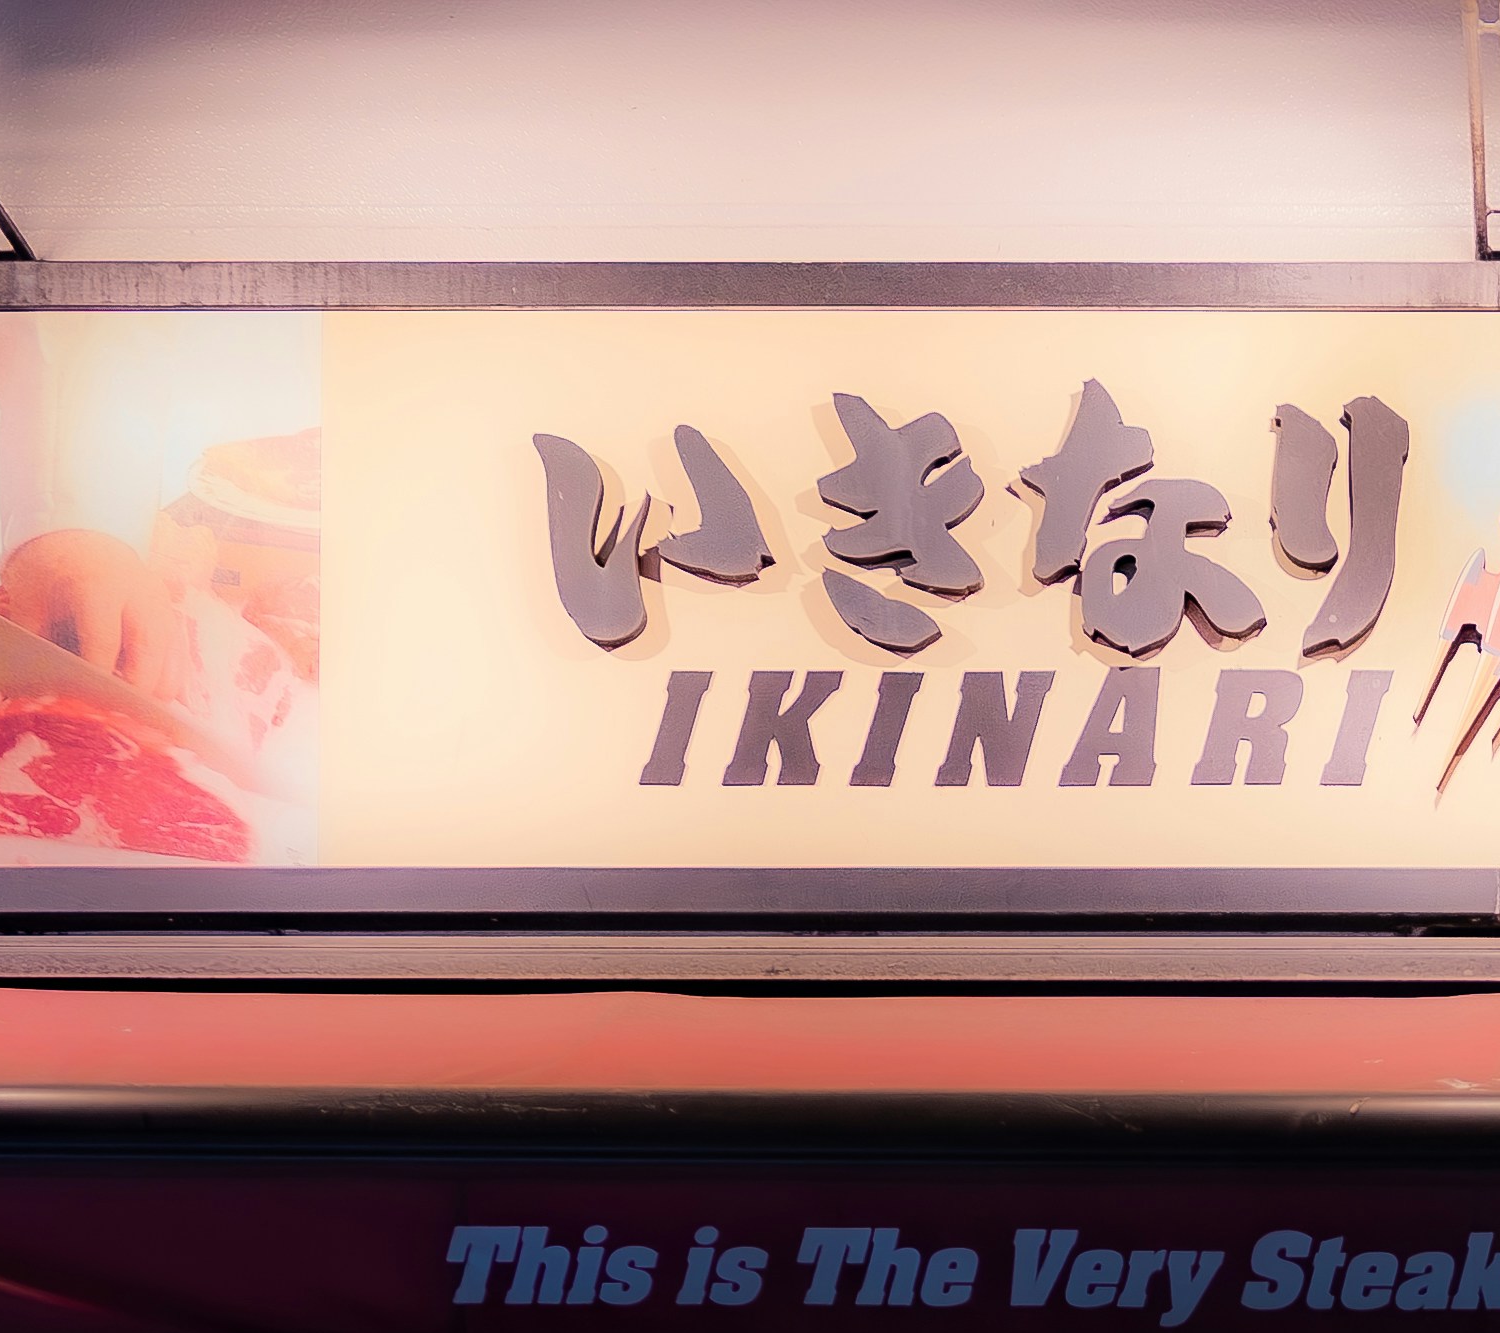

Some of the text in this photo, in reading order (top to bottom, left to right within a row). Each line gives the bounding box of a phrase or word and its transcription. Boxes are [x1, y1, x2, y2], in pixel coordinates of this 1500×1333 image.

[533, 378, 1408, 657] いきなり
[639, 669, 1393, 787] IKINARI
[447, 1224, 658, 1307] This
[676, 1224, 768, 1307] is
[796, 1227, 979, 1308] The
[1009, 1228, 1225, 1327] Very
